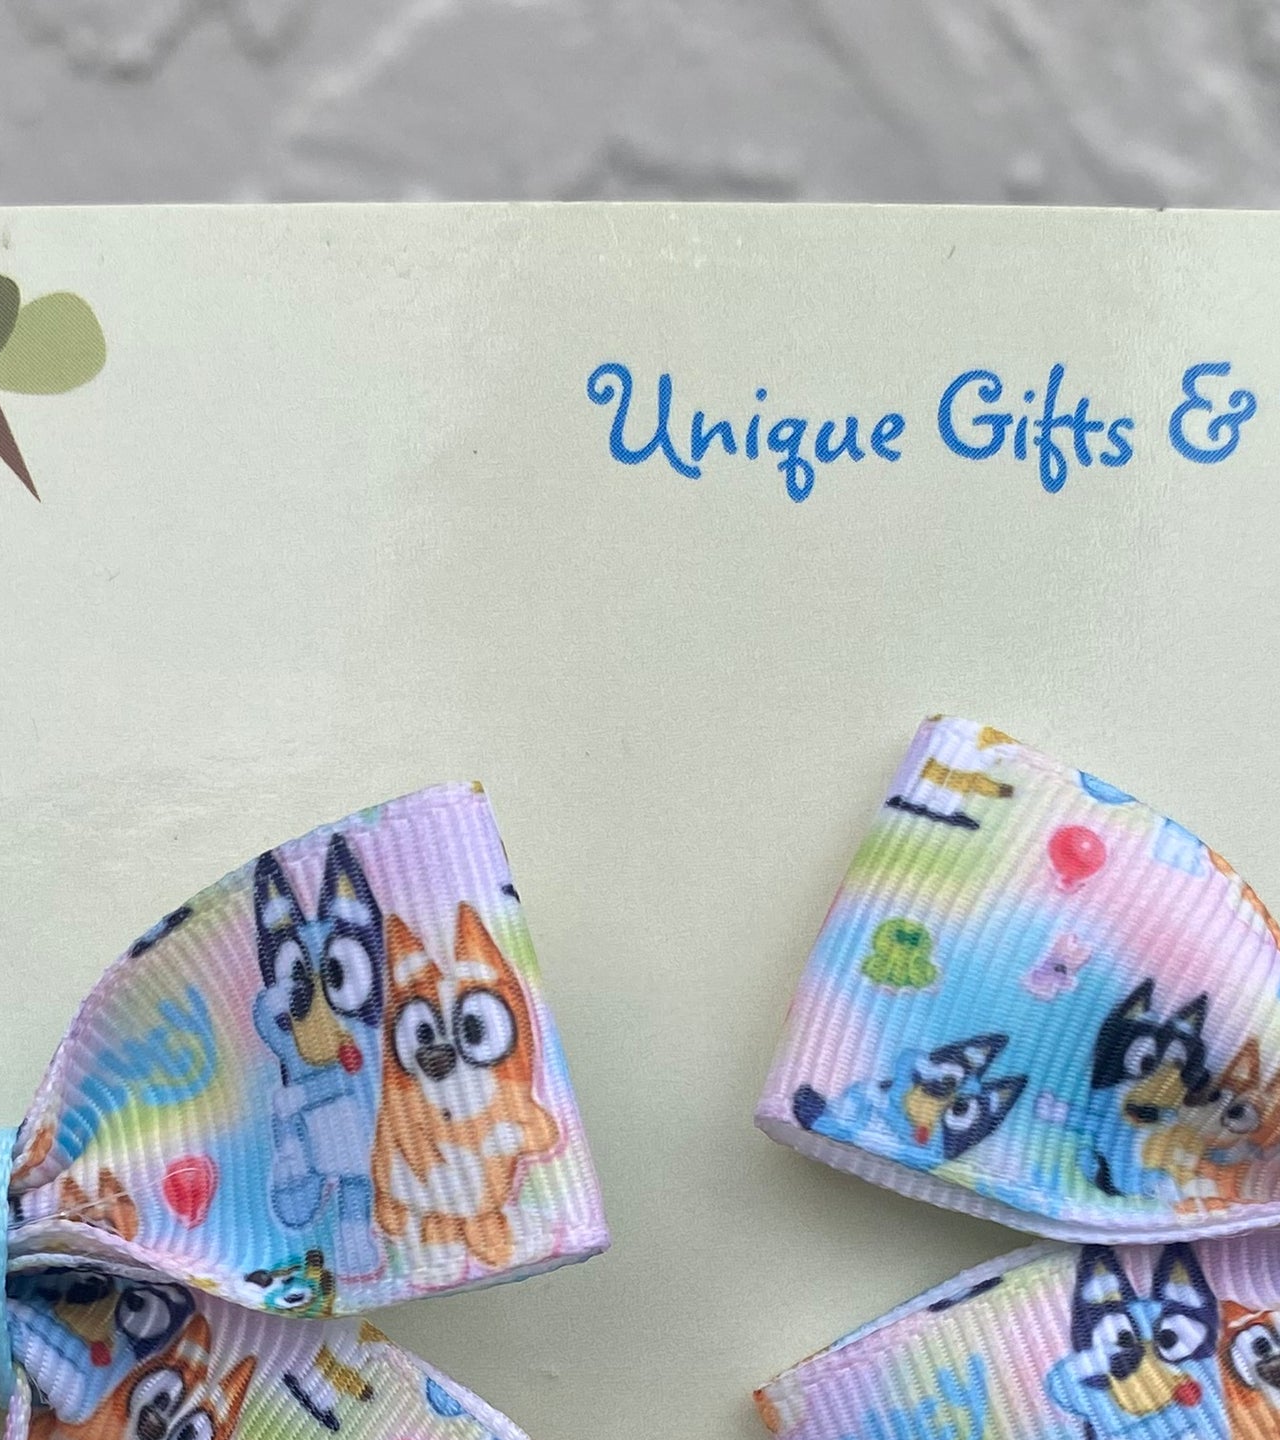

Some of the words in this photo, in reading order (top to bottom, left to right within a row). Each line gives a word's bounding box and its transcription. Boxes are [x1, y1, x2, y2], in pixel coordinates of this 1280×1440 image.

[586, 361, 907, 503] Unique
[937, 362, 1136, 494] Gifts
[1167, 360, 1258, 465] &
